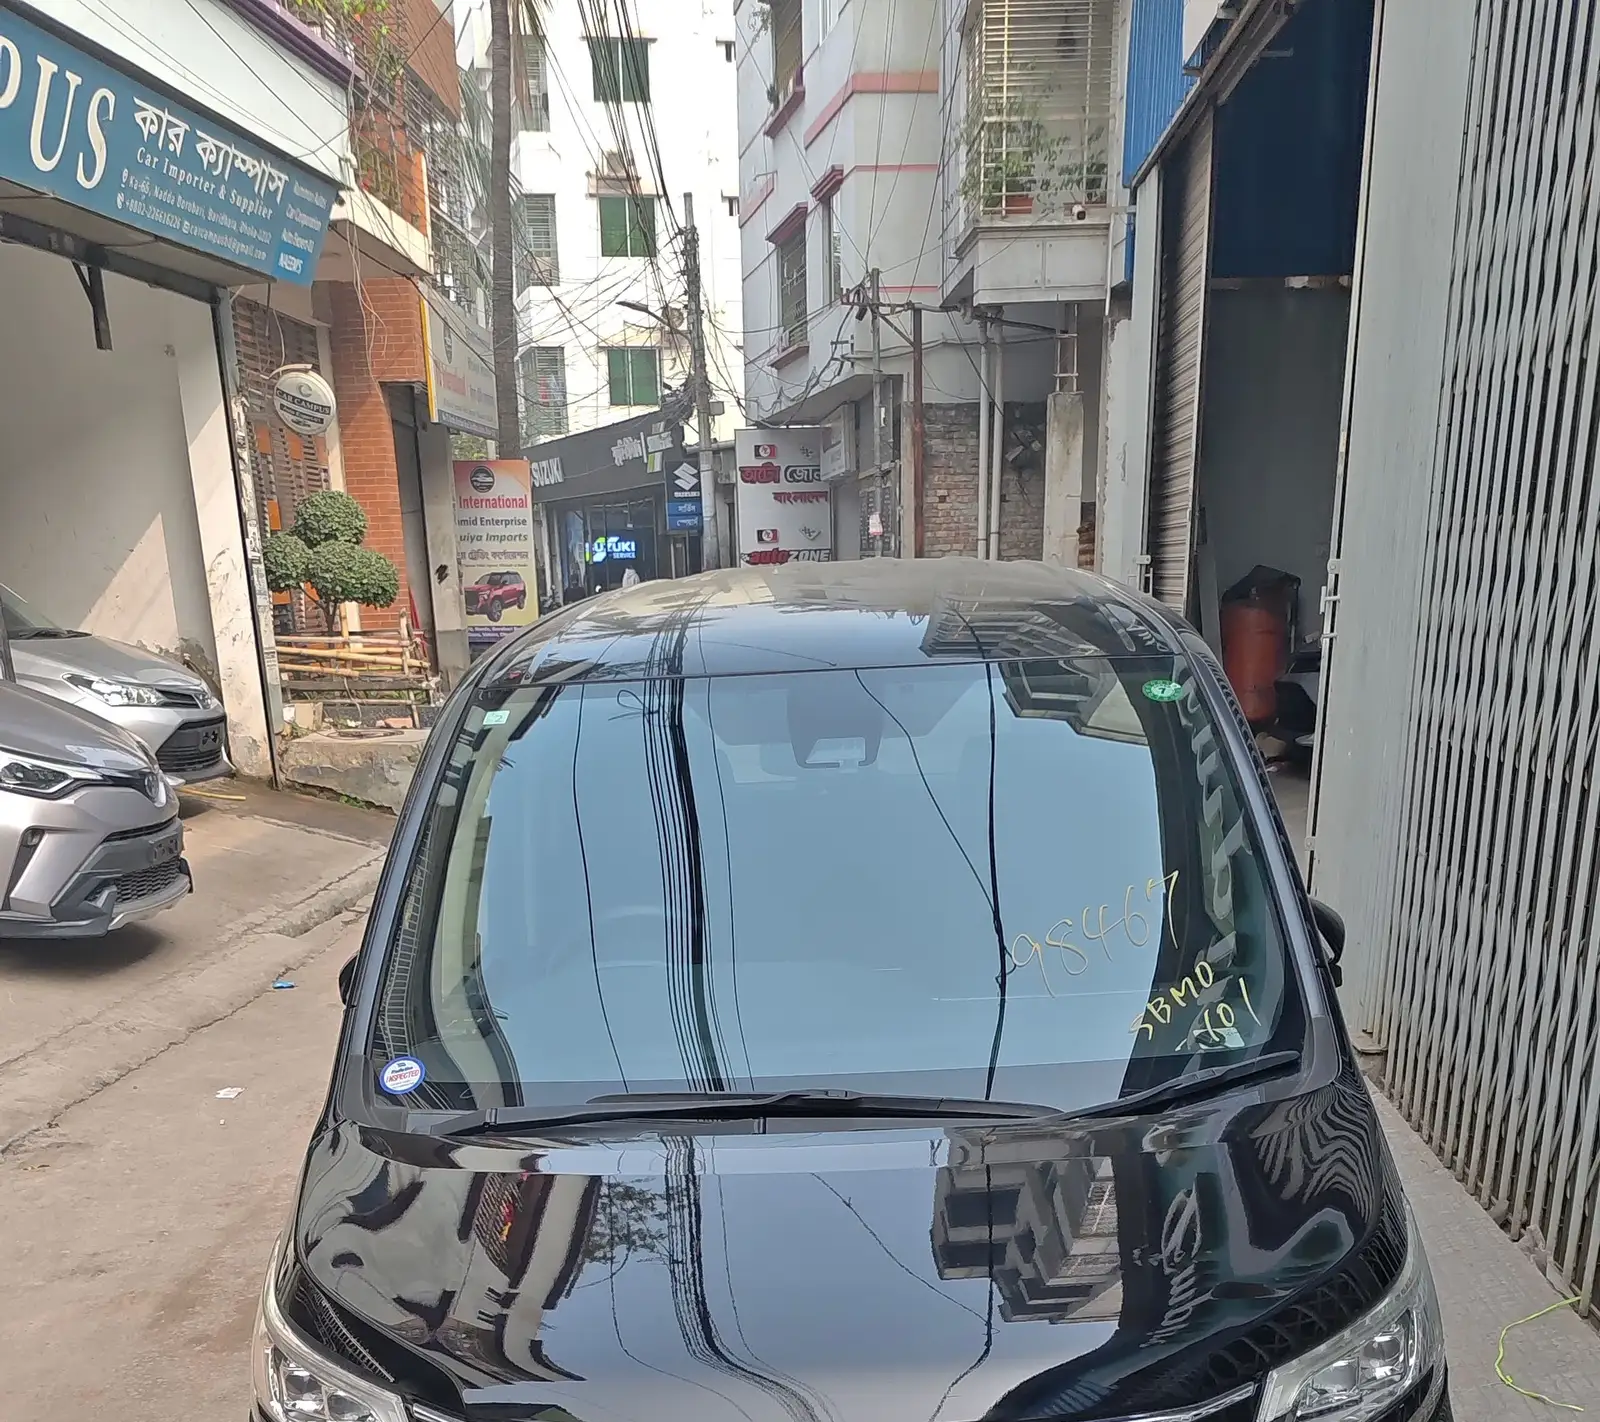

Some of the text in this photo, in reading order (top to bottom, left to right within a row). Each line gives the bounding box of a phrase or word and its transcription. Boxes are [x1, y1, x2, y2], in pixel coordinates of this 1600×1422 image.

[133, 96, 191, 158] কার
[194, 128, 289, 205] ক্যাম্পাস
[136, 146, 159, 169] Car
[163, 157, 216, 195] Importer
[217, 184, 227, 200] &
[229, 188, 273, 220] Supplier
[276, 388, 330, 414] CAR CAMPUS
[531, 456, 564, 488] SUZUKI
[739, 462, 781, 484] অটো
[459, 494, 528, 509] International
[772, 490, 829, 505] বাংলাদেশ
[480, 516, 528, 528] Enterprise
[486, 532, 528, 544] Imports
[1012, 869, 1180, 999] 98467
